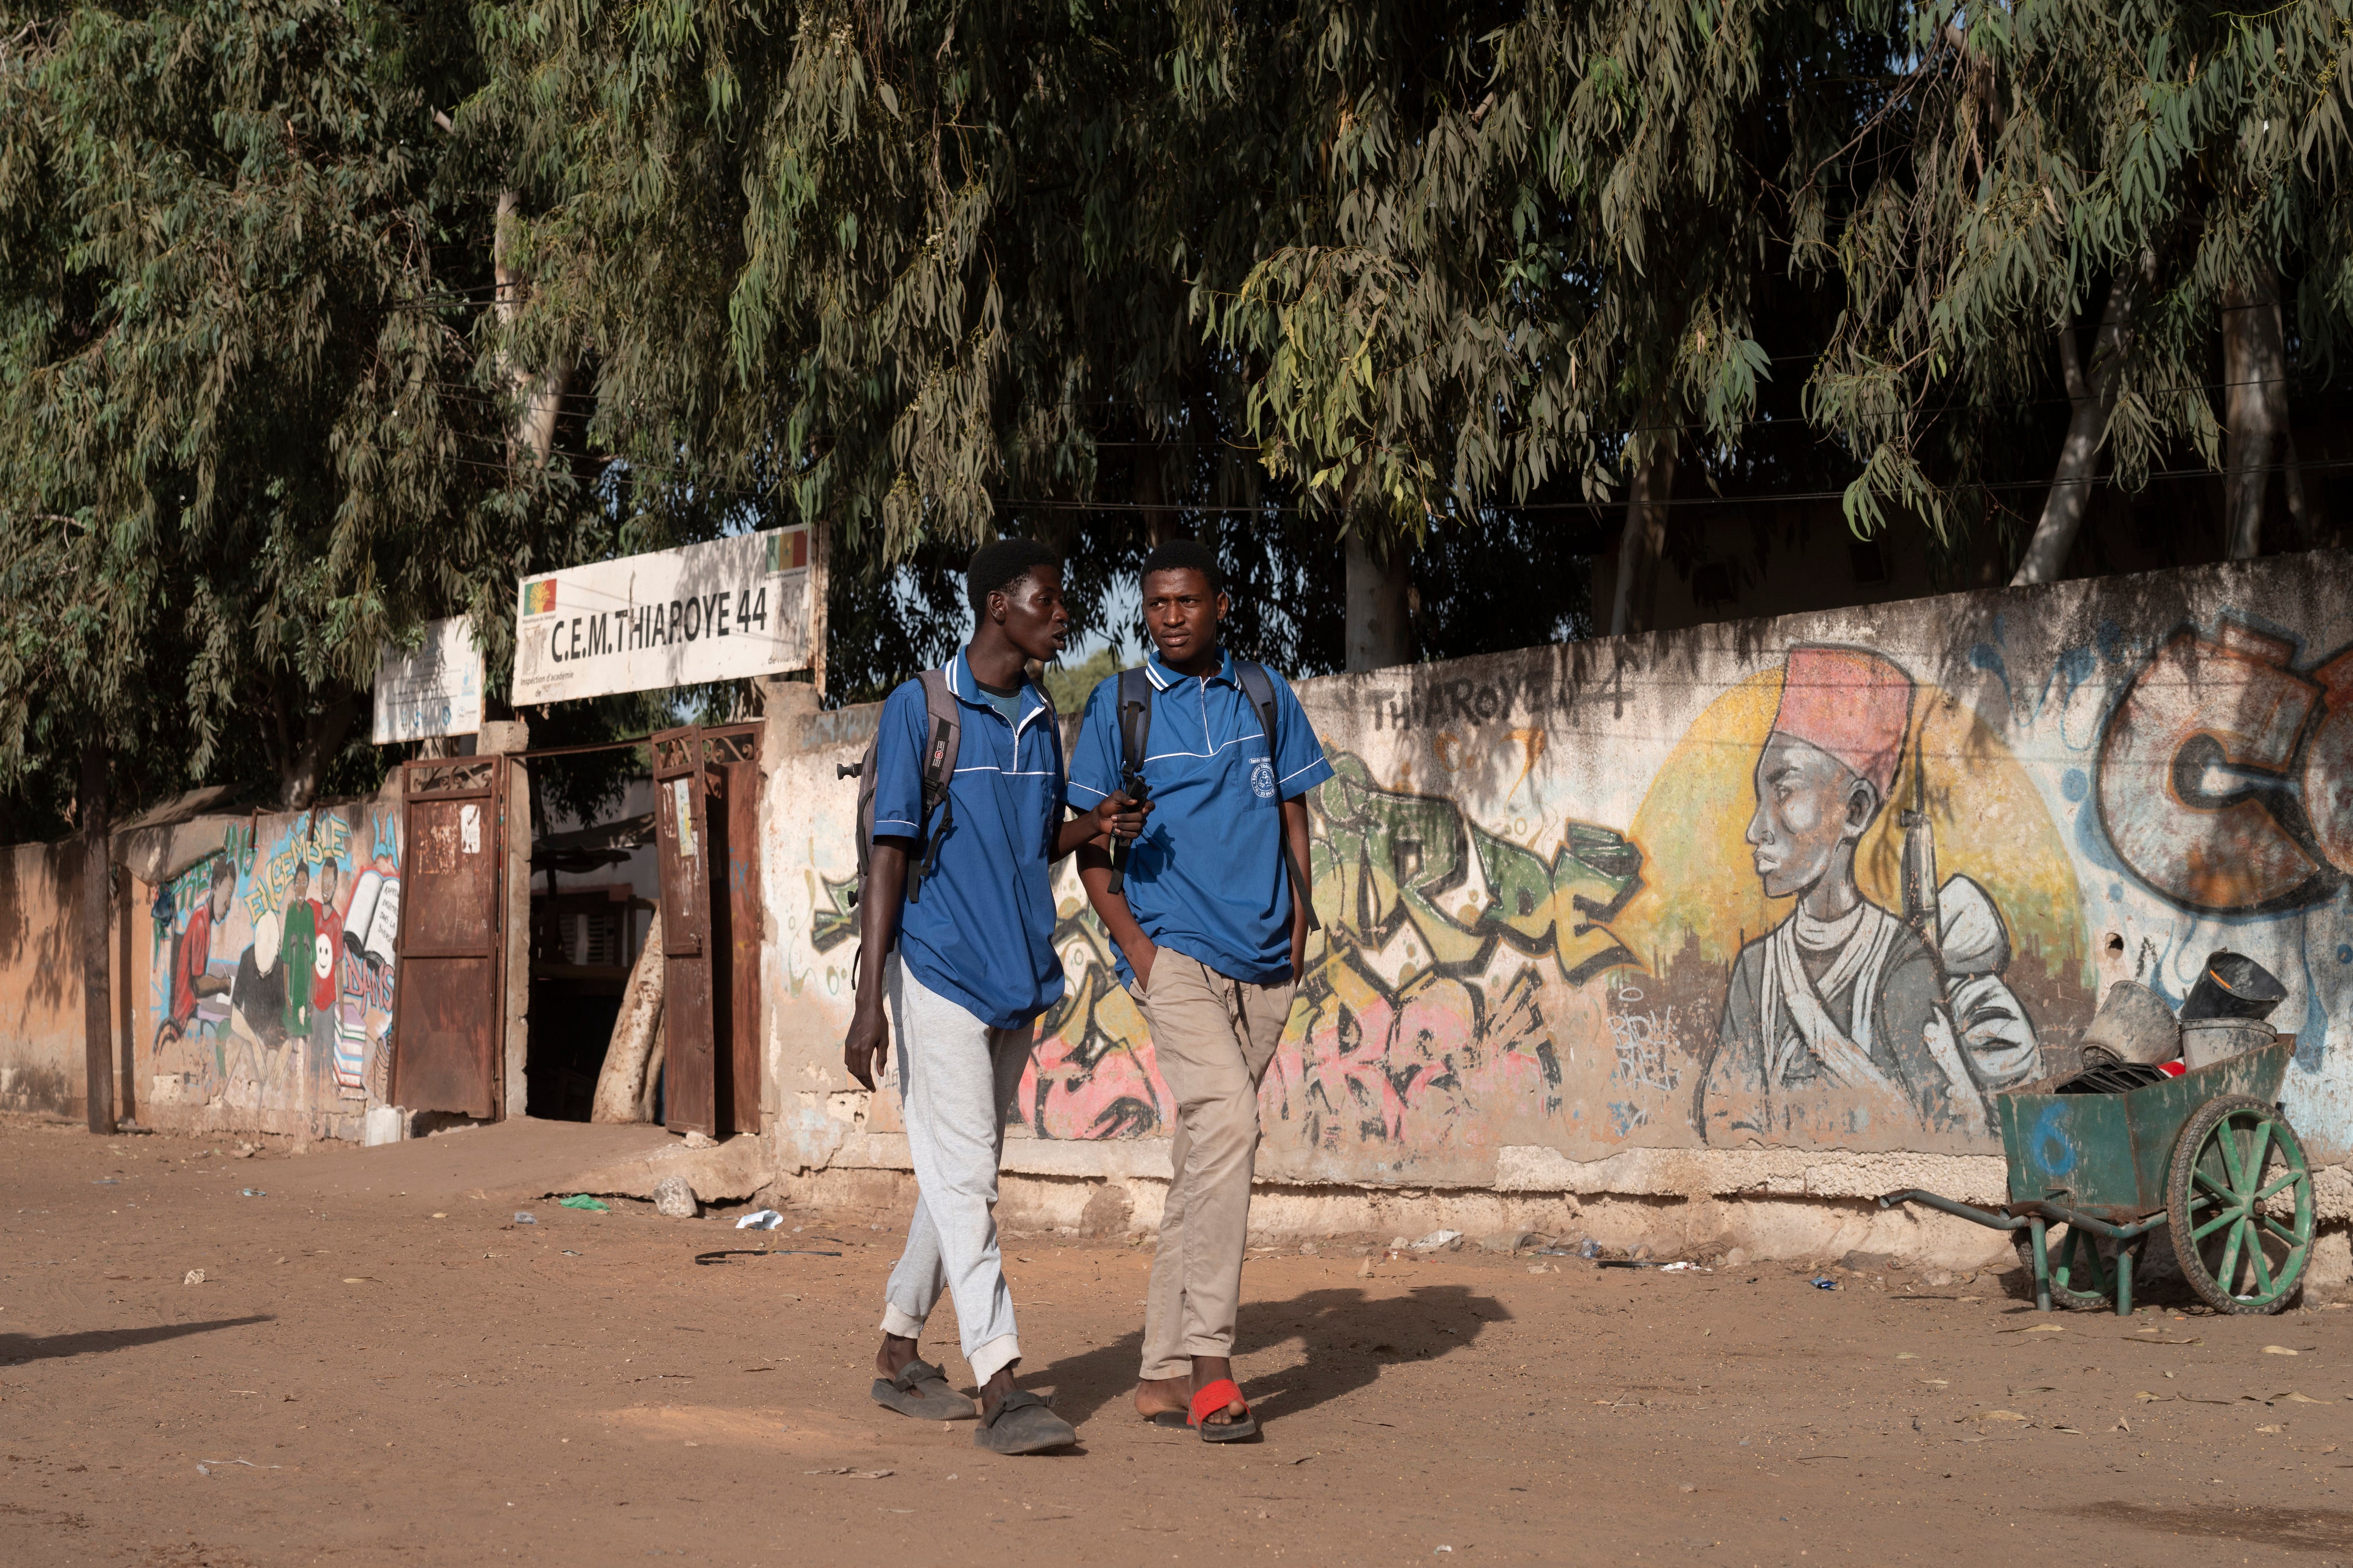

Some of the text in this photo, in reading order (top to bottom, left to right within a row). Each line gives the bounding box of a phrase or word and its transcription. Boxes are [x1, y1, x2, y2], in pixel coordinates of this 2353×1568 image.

[737, 587, 767, 633] 44
[535, 689, 542, 697] de
[244, 811, 352, 928] ENSEMBLE
[371, 808, 400, 872] LA
[343, 942, 395, 1018] DANS
[2033, 1100, 2077, 1177] 6
